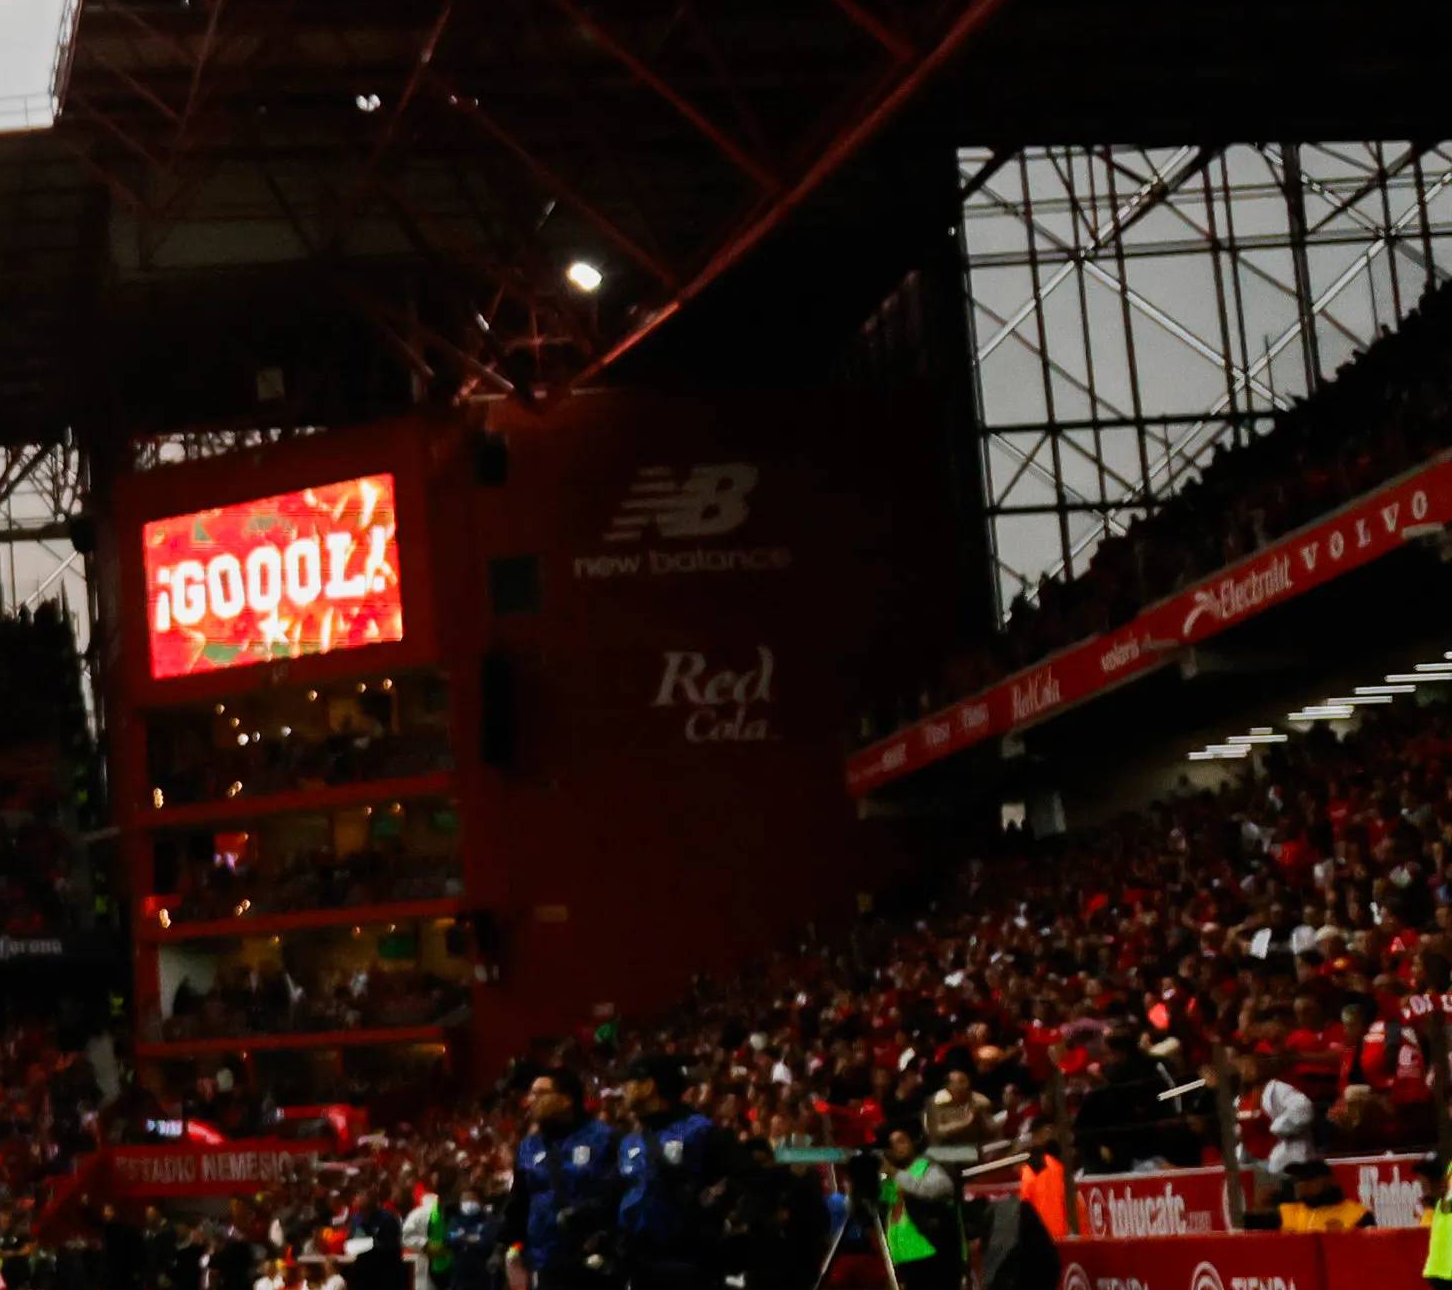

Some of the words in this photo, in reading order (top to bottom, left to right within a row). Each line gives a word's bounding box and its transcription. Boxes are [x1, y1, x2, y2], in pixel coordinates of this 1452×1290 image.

[1298, 489, 1429, 573] VOLVO
[155, 526, 387, 633] ¡GOOOL!
[649, 642, 775, 708] Red
